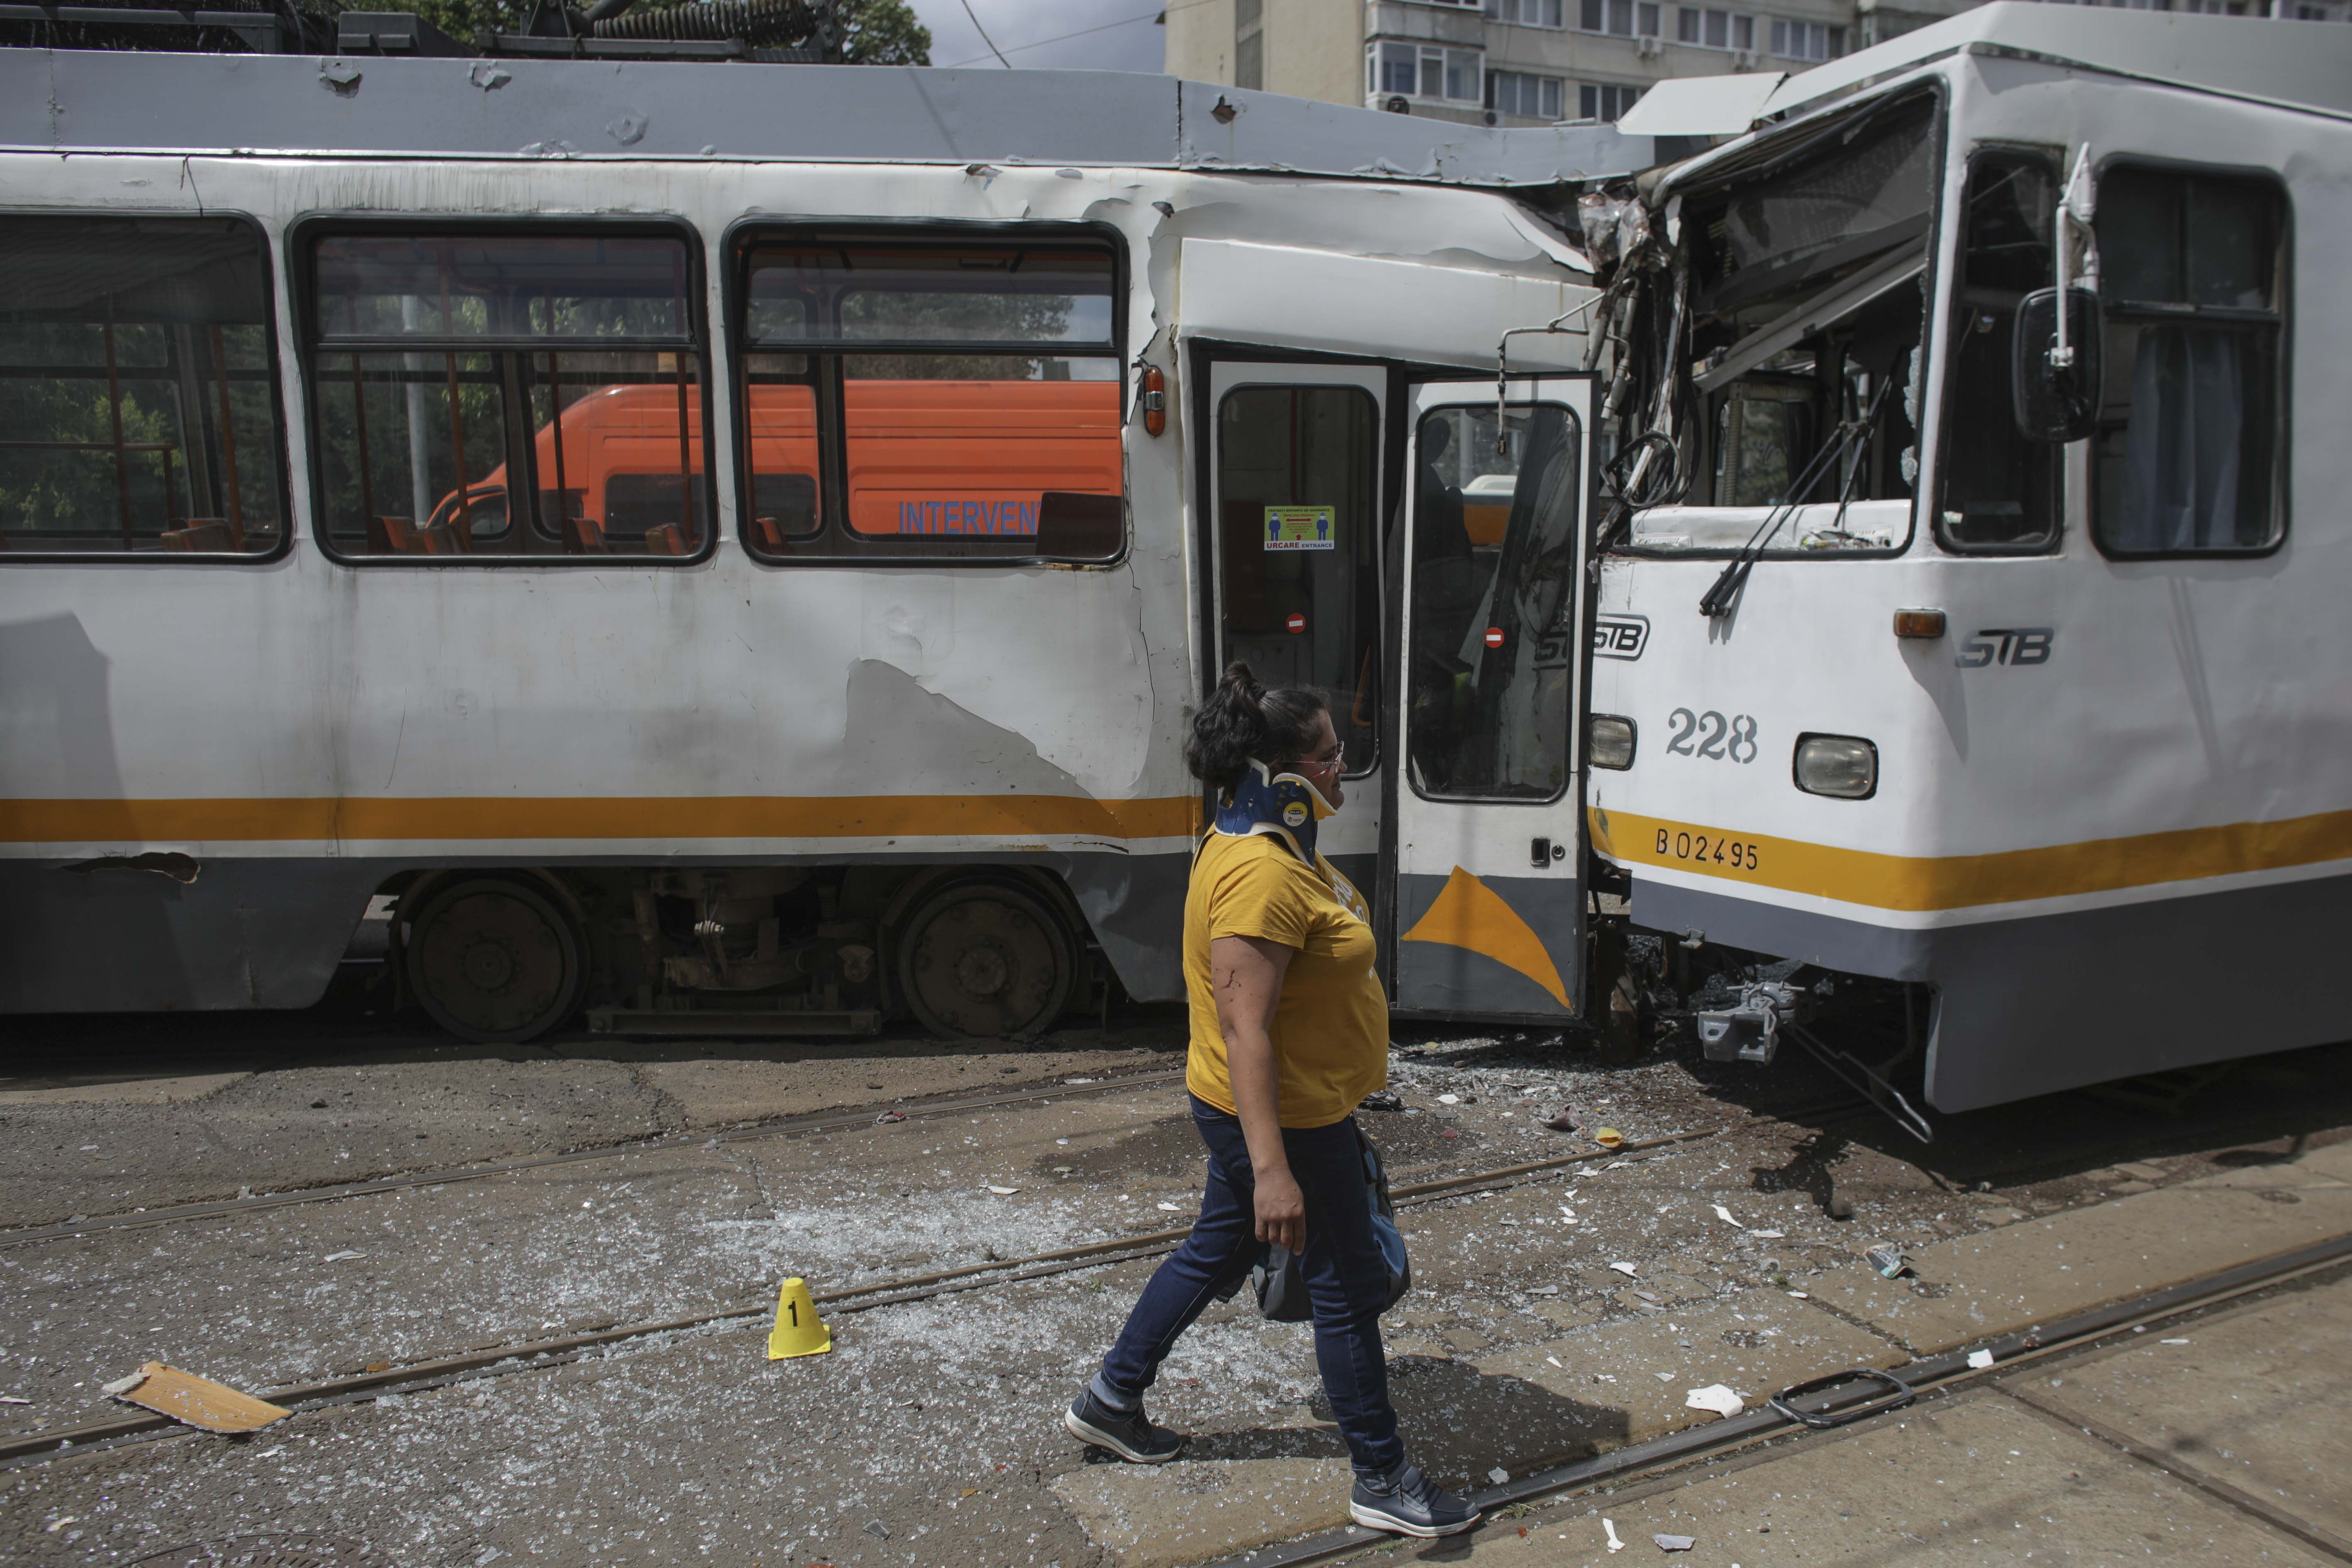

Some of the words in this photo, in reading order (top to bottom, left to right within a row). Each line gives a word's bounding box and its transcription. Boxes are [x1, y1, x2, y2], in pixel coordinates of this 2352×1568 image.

[899, 501, 1042, 534] INTERVEN
[1954, 628, 2054, 668] STB
[1666, 707, 1757, 764] 228
[788, 1301, 798, 1327] 1
